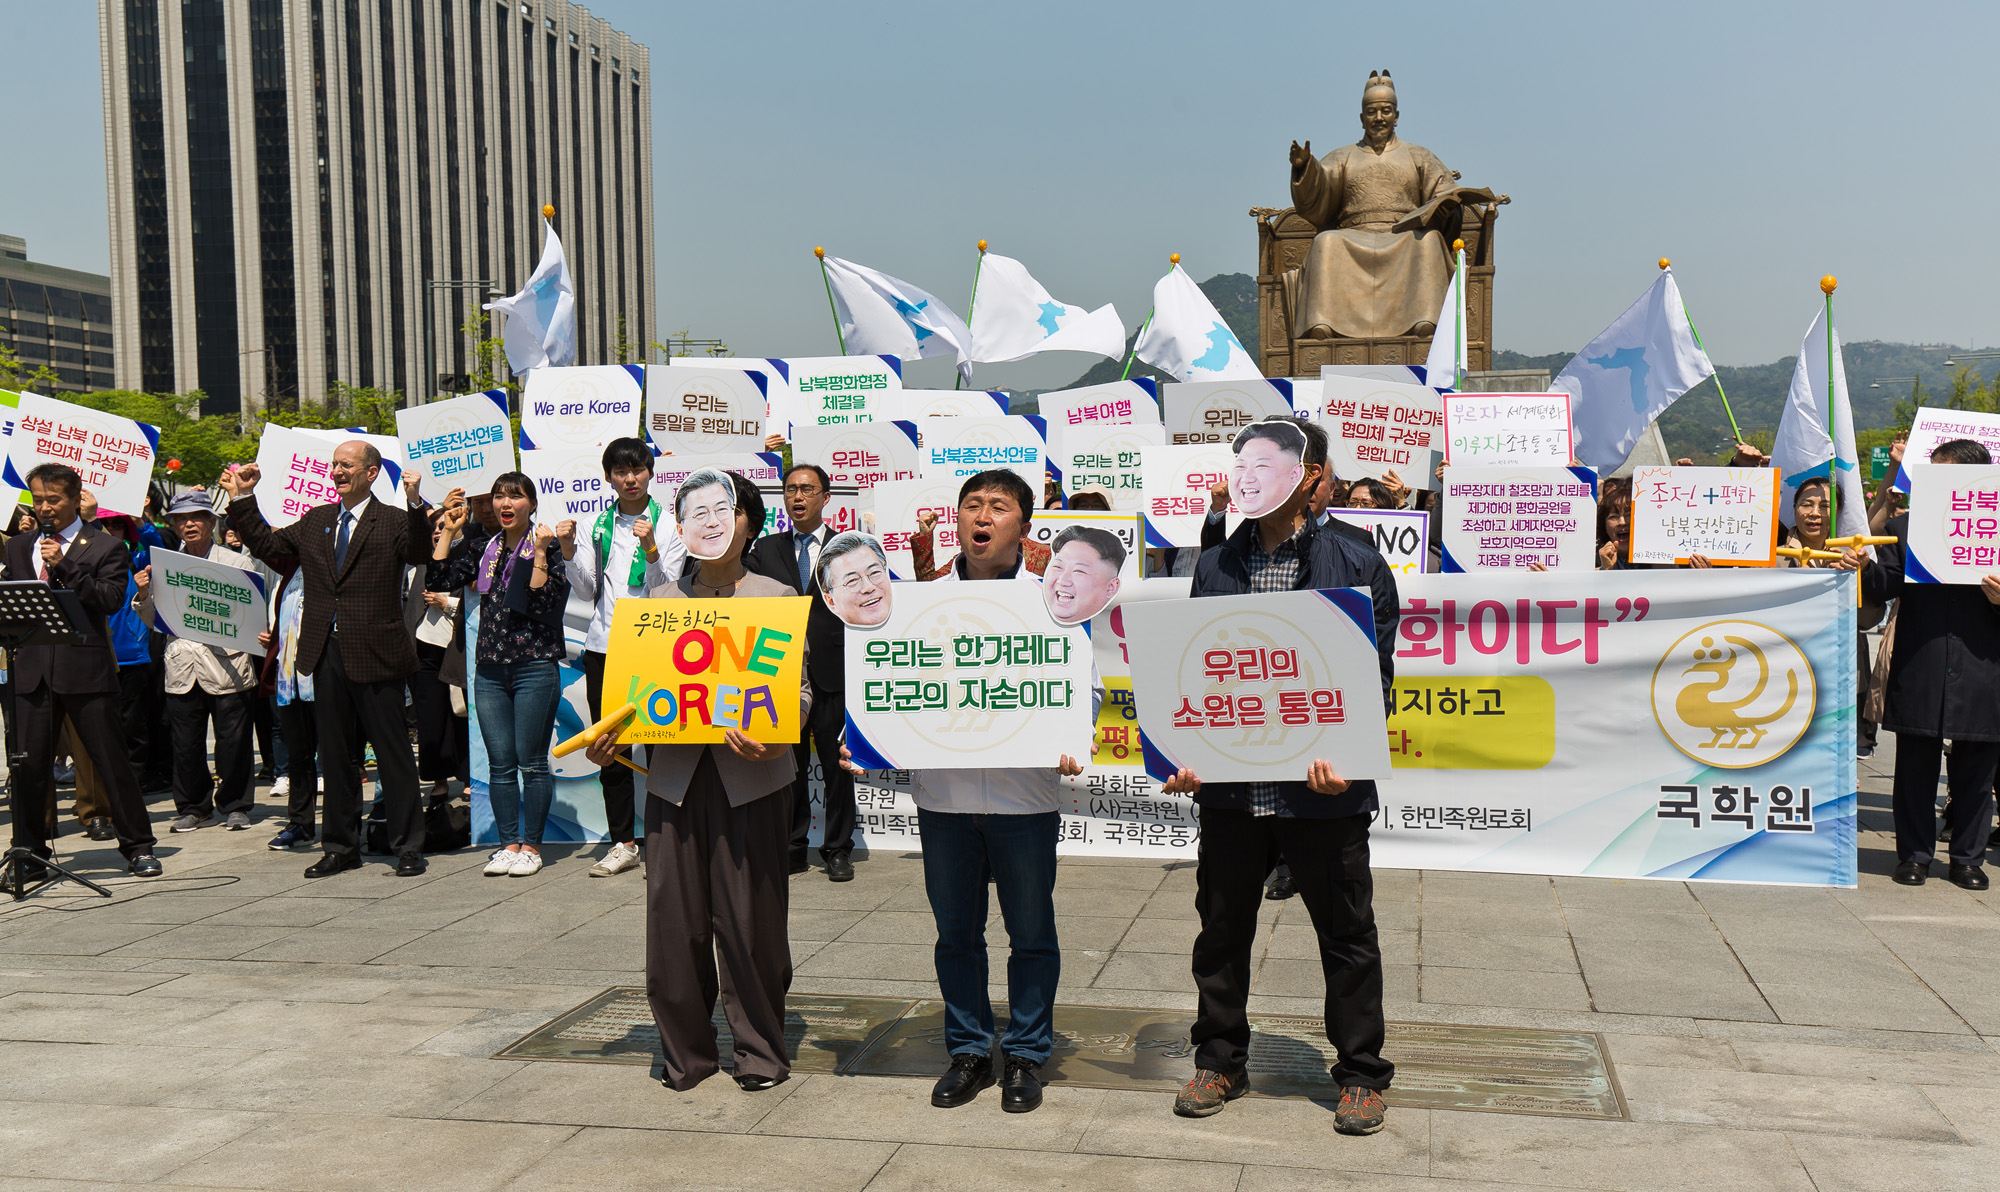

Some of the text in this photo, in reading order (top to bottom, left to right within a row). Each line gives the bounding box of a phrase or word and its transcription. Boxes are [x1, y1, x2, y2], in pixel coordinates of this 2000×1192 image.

[799, 374, 888, 392] 남북평화협정
[534, 400, 631, 415] We are Korea
[682, 394, 728, 413] 우리는
[822, 395, 866, 410] 체결을
[1067, 399, 1132, 425] 남북여행
[1326, 399, 1356, 418] 상설
[1360, 402, 1389, 421] 남북
[1453, 404, 1567, 424] 부르자 세계평화
[652, 413, 760, 436] 통일을 원합니다
[1204, 409, 1254, 428] 우리는
[1920, 421, 1976, 435] 비무장지대
[21, 415, 54, 436] 상설
[57, 423, 88, 444] 남북
[92, 433, 151, 461] 이산가족
[407, 424, 504, 460] 남북종전선언을
[1342, 421, 1431, 447] 협의체 구성을
[1454, 432, 1568, 455] 이루자 조국통일
[36, 438, 129, 474] 협의체 구성을
[431, 452, 485, 478] 원합니다
[832, 450, 880, 469] 우리는
[931, 447, 1038, 464] 남북종전선언을
[1072, 454, 1113, 469] 우리는
[1356, 445, 1410, 465] 원합니다
[748, 467, 777, 480] 지뢰를
[539, 478, 565, 495] We
[572, 478, 601, 492] are
[1450, 483, 1591, 498] 비무장지대 철조망과 지뢰를
[1650, 481, 1698, 509] 종전
[1151, 497, 1206, 516] 종전을
[1468, 501, 1572, 515] 제거하여 평화공원을
[1462, 519, 1577, 533] 조성하고 세계자연유산
[1480, 537, 1557, 550] 보호지역으로의
[1477, 553, 1560, 568] 지정을 원합니다
[165, 569, 252, 605] 남북평화협정
[188, 594, 231, 618] 체결을
[183, 613, 238, 639] 원합니다
[672, 626, 792, 677] ONE
[864, 639, 944, 669] 우리는
[952, 634, 1072, 667] 한겨레다
[1203, 647, 1300, 684] 우리의
[623, 675, 779, 729] KOREA
[864, 678, 1074, 712] 단군의 자손이다
[1172, 689, 1346, 728] 소원은 통일
[1086, 774, 1151, 797] 광화문
[1401, 805, 1532, 832] 한민족원로회
[1657, 784, 1815, 832] 국학원
